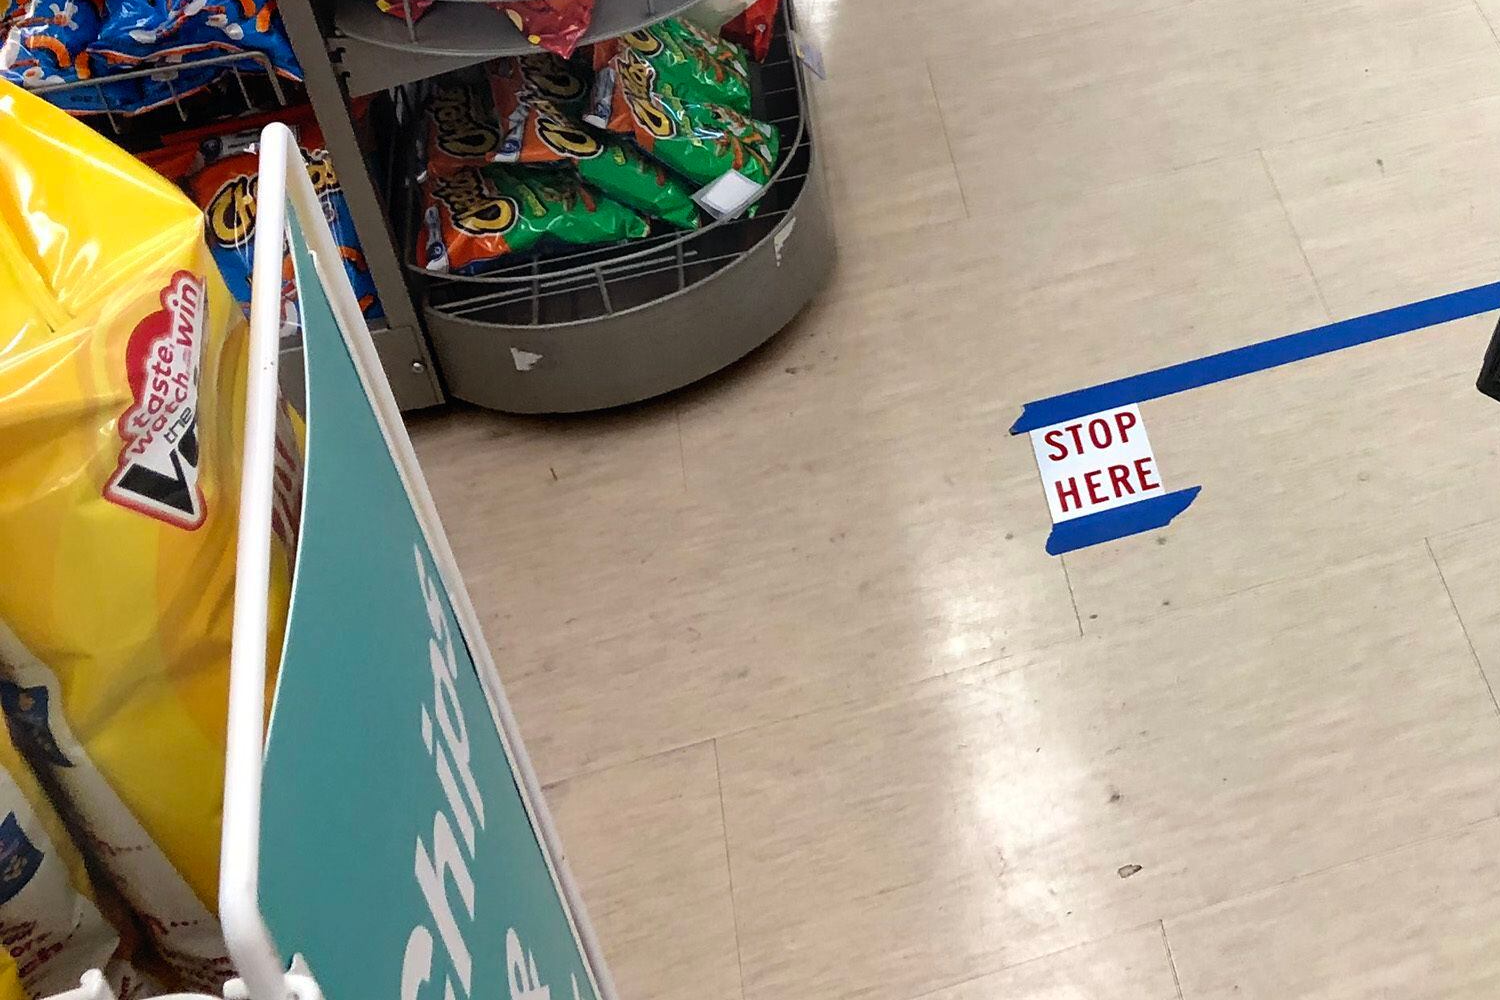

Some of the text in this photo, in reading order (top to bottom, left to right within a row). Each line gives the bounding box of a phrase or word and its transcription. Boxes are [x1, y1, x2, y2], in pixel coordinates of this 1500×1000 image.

[132, 371, 190, 454] watch
[177, 283, 198, 348] win
[163, 406, 192, 444] the
[1044, 411, 1137, 461] STOP
[1055, 456, 1160, 513] HERE
